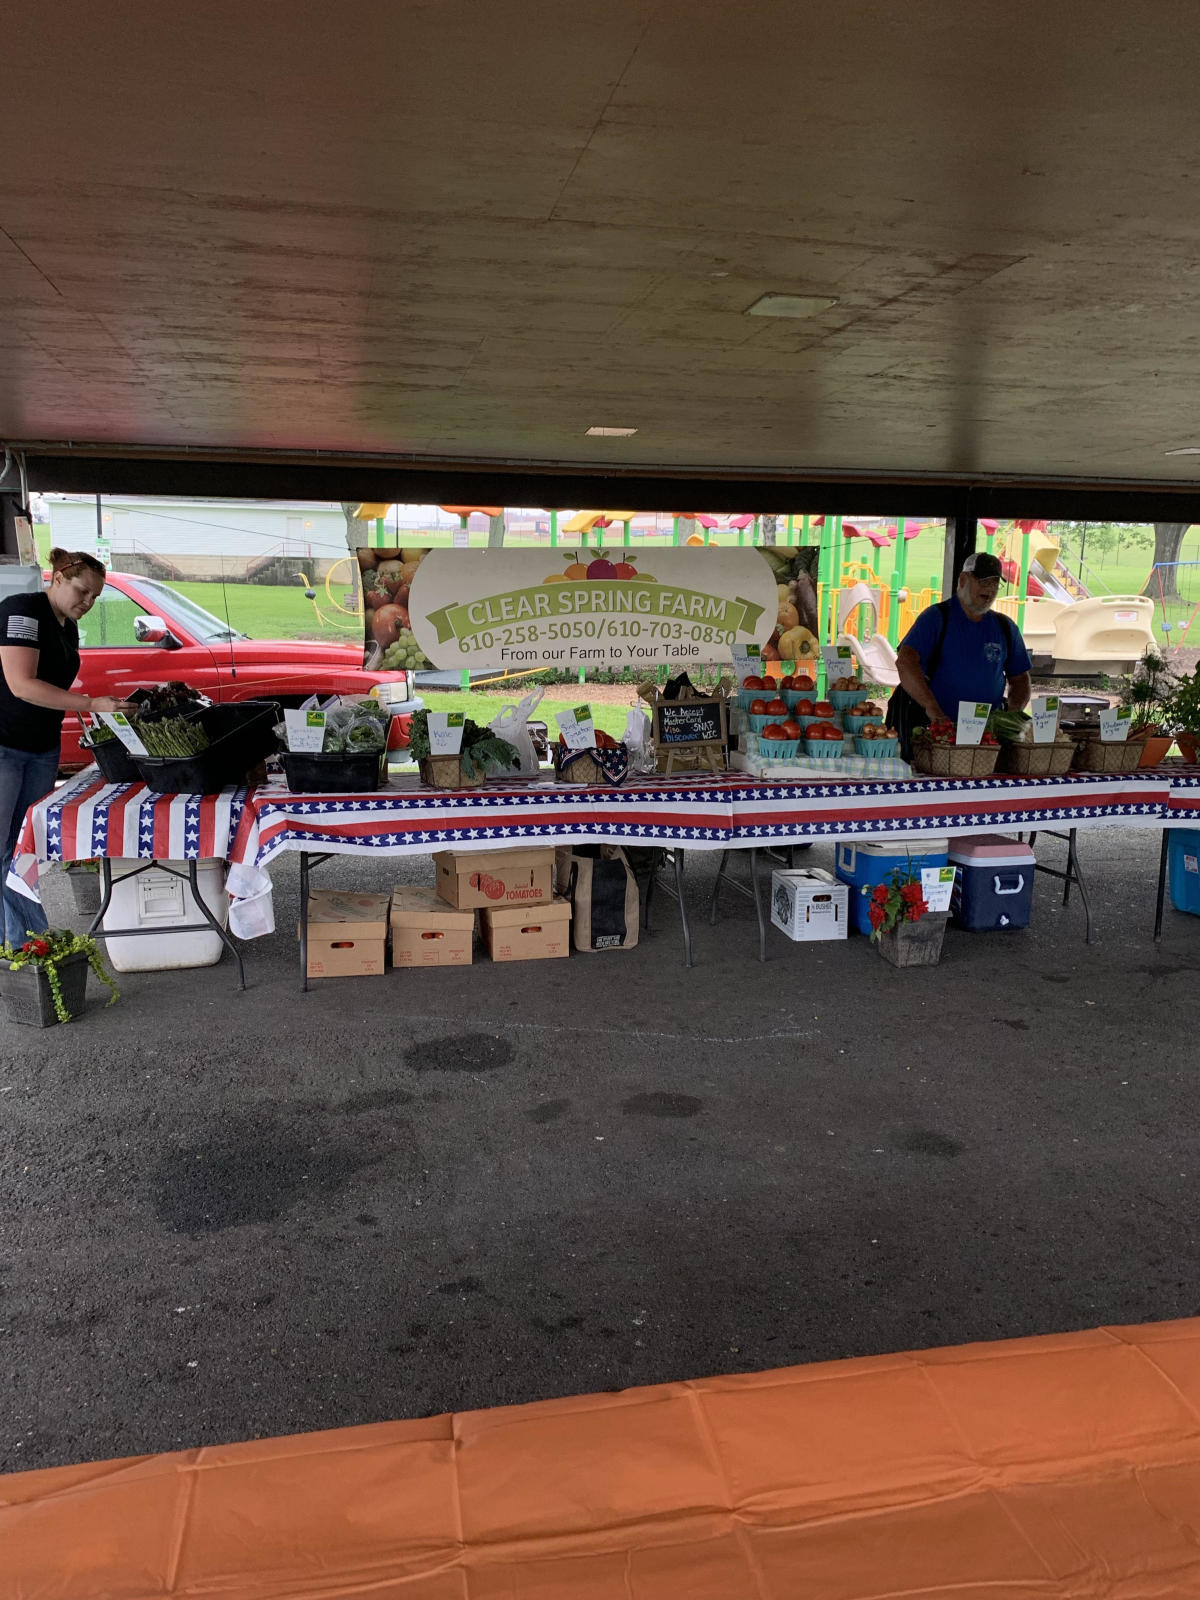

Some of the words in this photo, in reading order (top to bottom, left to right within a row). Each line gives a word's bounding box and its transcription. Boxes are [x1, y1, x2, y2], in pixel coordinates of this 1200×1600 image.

[467, 593, 552, 625] CLEAR
[558, 590, 651, 613] SPRING
[659, 592, 727, 621] FARM
[458, 618, 737, 653] 610-258-5050/610-703-0850
[501, 648, 538, 660] From
[542, 650, 565, 660] our
[570, 646, 605, 659] Farm
[610, 646, 622, 657] to
[627, 645, 659, 657] Your
[663, 644, 700, 656] Table
[664, 707, 677, 717] We
[702, 730, 718, 740] WIC
[506, 888, 543, 900] TOMATOES
